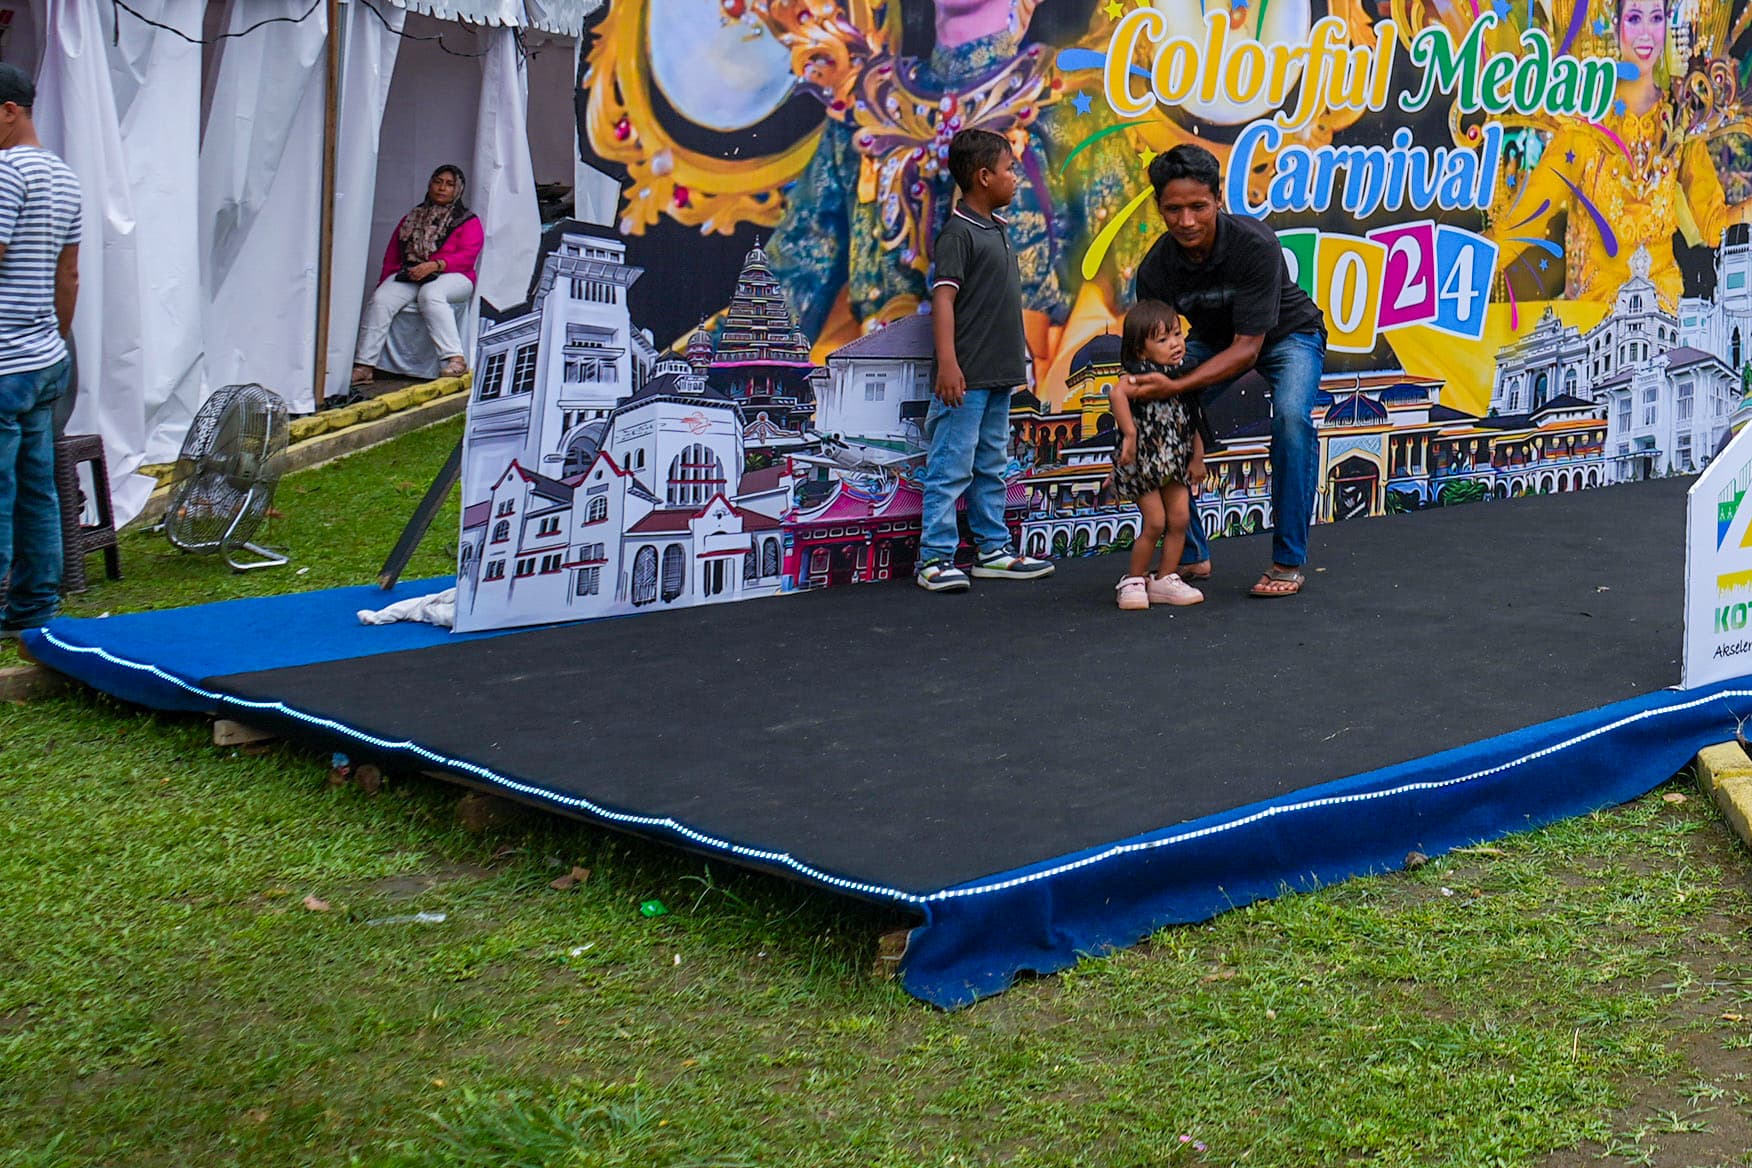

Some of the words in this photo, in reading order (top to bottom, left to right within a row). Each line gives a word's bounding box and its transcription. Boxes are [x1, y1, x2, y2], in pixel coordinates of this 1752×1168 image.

[1104, 7, 1398, 128] Colorful
[1399, 10, 1617, 123] Medan
[1226, 121, 1504, 220] Carnival
